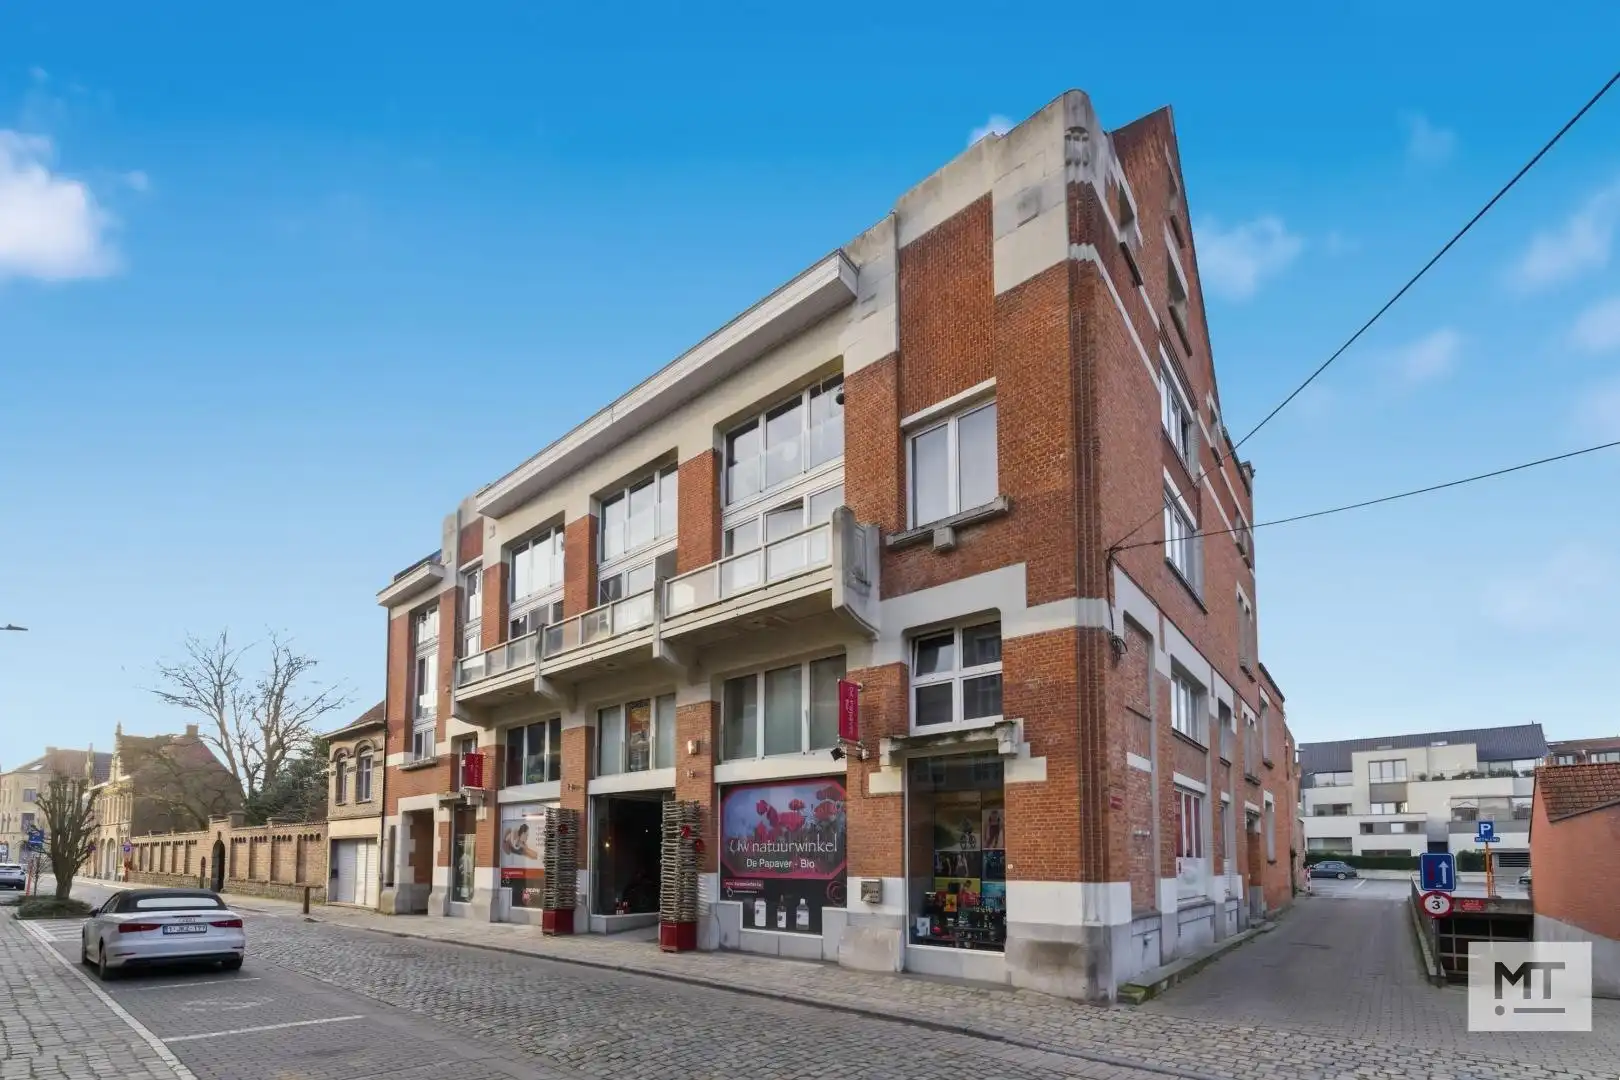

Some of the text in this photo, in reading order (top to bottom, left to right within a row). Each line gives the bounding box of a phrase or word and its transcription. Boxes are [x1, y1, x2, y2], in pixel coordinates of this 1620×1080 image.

[1480, 823, 1491, 835] P
[752, 833, 838, 853] natuurwinkel
[746, 858, 757, 868] De
[759, 858, 792, 869] Papaver
[800, 858, 815, 868] Bio
